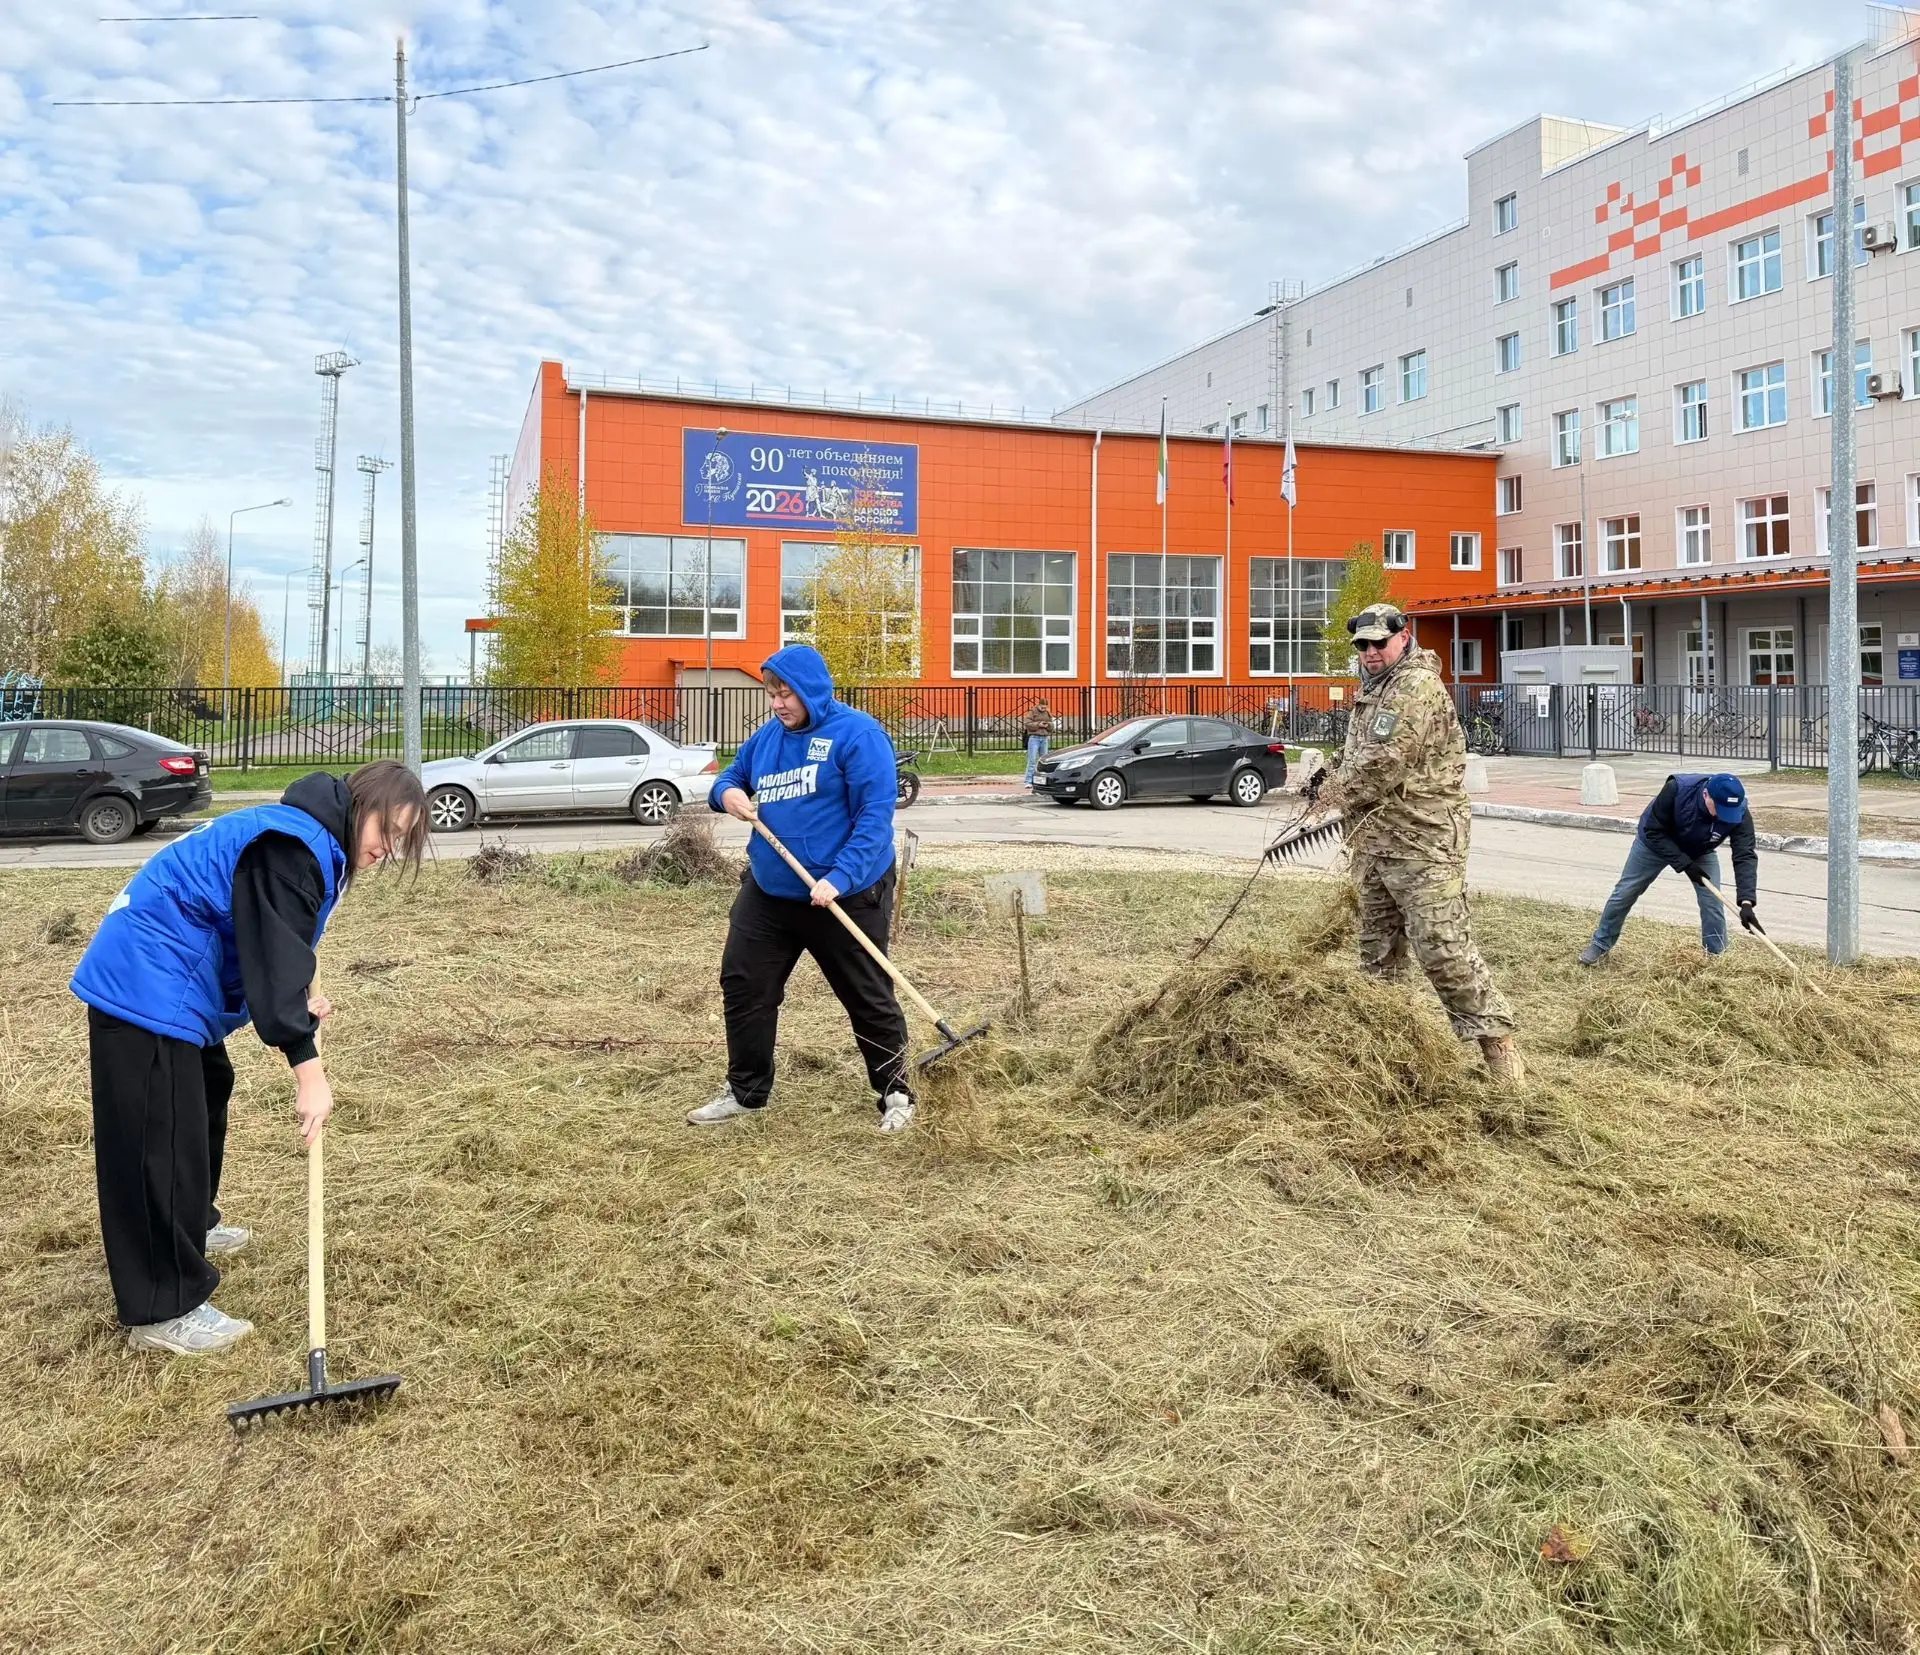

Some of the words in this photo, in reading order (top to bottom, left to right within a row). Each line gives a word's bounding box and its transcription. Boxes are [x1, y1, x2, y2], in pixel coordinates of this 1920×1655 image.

[750, 447, 784, 473] 90
[787, 448, 813, 459] лет
[815, 447, 904, 465] объединяем
[821, 465, 904, 480] поколения!
[746, 489, 804, 514] 2026
